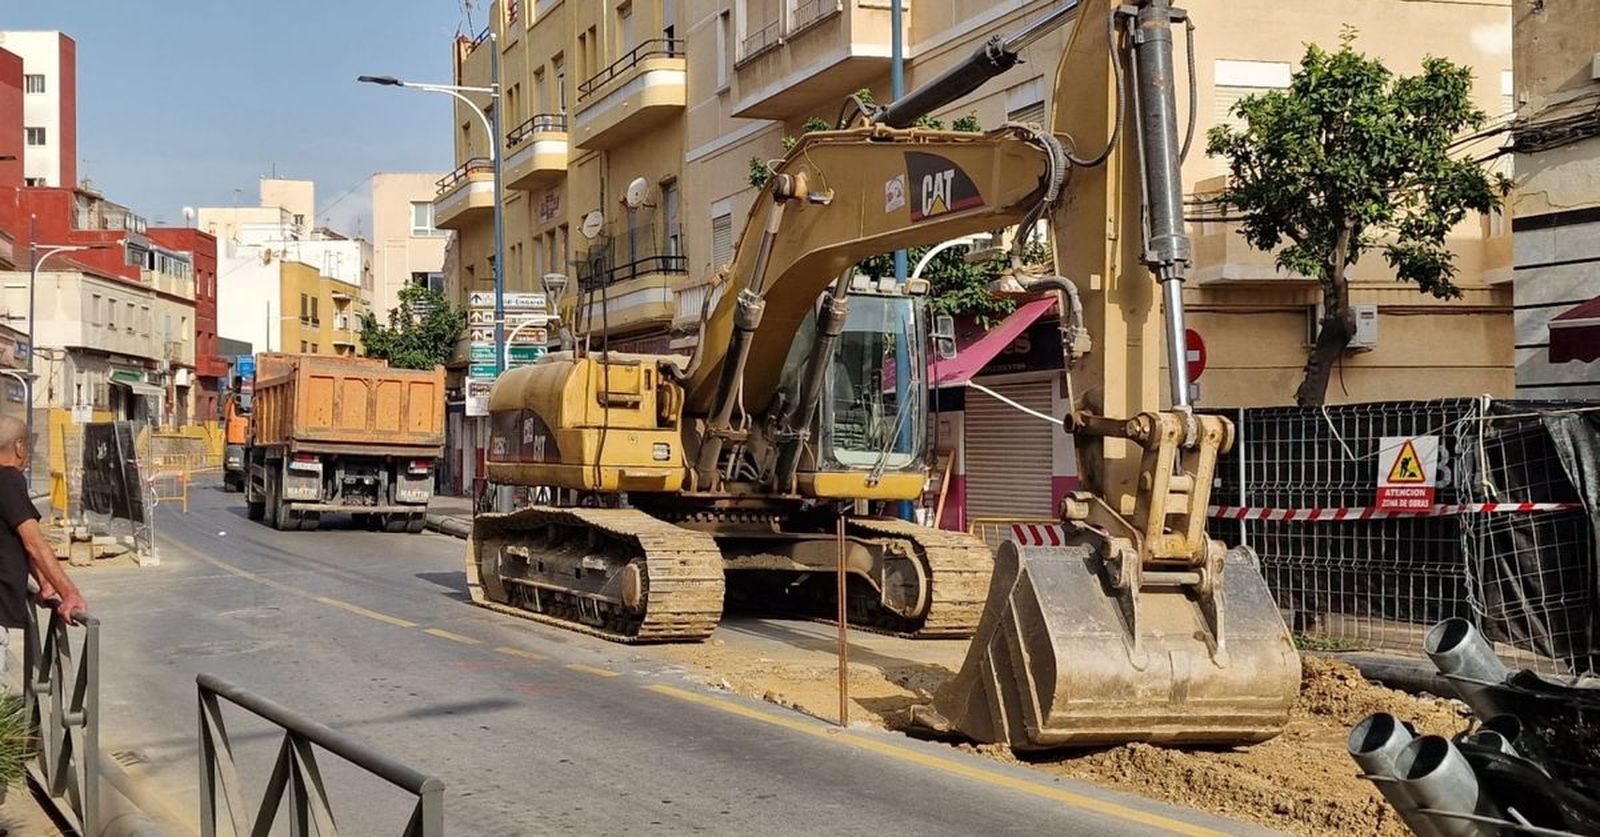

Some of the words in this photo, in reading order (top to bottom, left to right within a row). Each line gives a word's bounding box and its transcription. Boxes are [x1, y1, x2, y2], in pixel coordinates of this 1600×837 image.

[922, 169, 955, 217] CAT
[1385, 489, 1426, 497] ATENCION
[1399, 499, 1408, 507] DE
[1408, 499, 1429, 507] OBRAS
